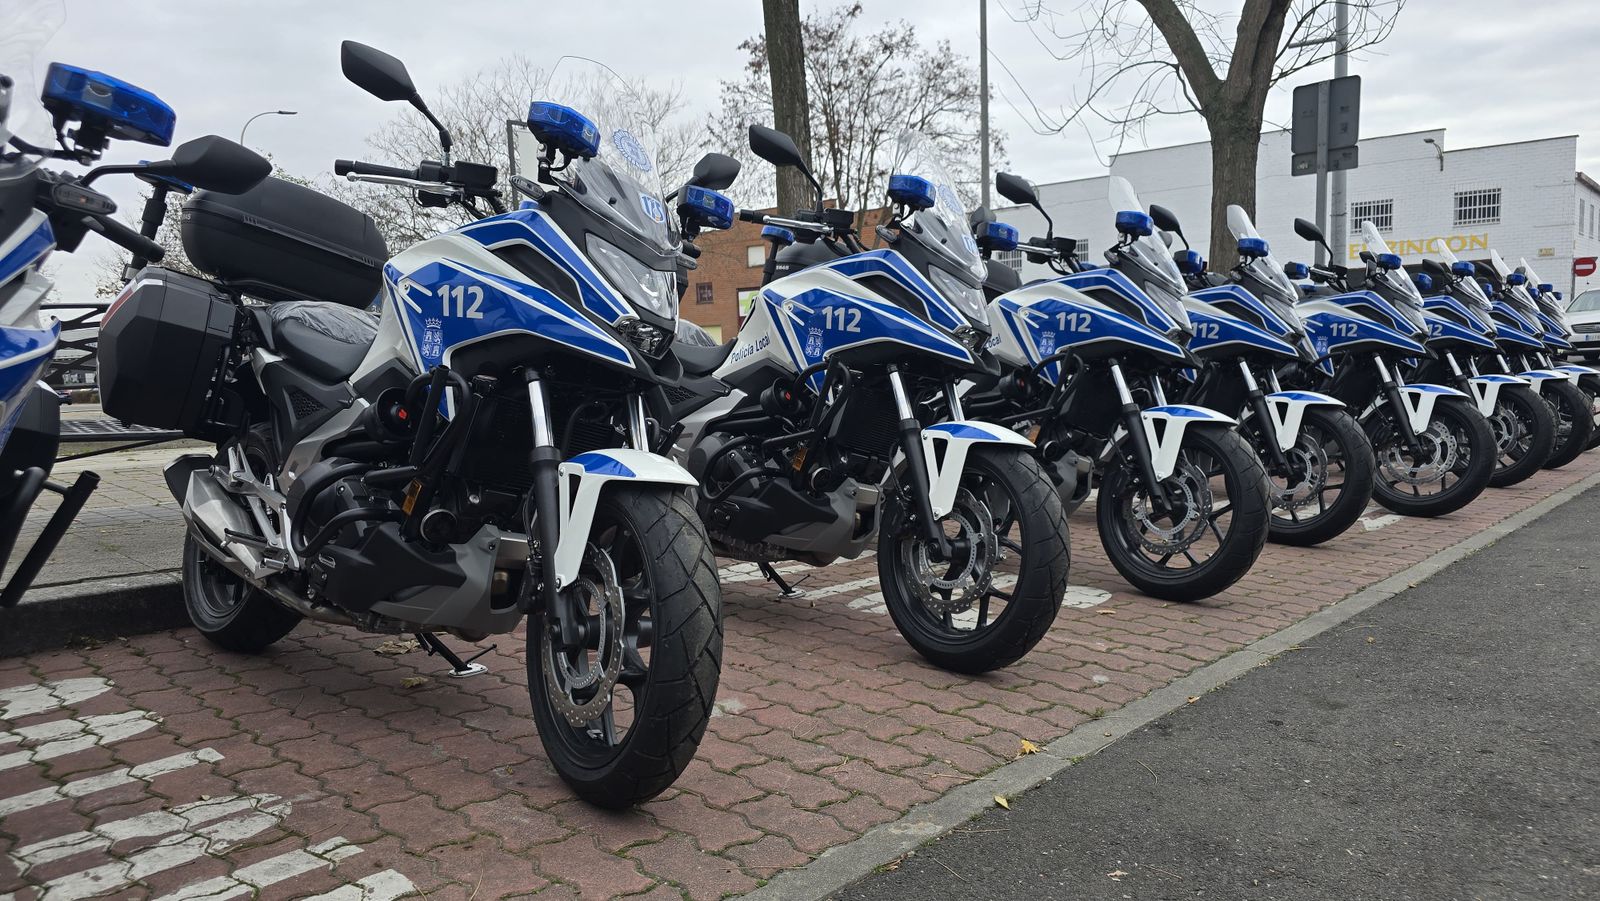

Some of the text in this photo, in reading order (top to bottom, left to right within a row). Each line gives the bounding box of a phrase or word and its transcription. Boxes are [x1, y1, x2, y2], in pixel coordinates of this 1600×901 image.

[437, 284, 484, 319] 112
[821, 305, 862, 333] 112
[1055, 311, 1092, 333] 112
[1330, 322, 1358, 337] 112
[985, 332, 1002, 348] ocal
[1428, 323, 1443, 337] 12
[755, 331, 771, 352] Local
